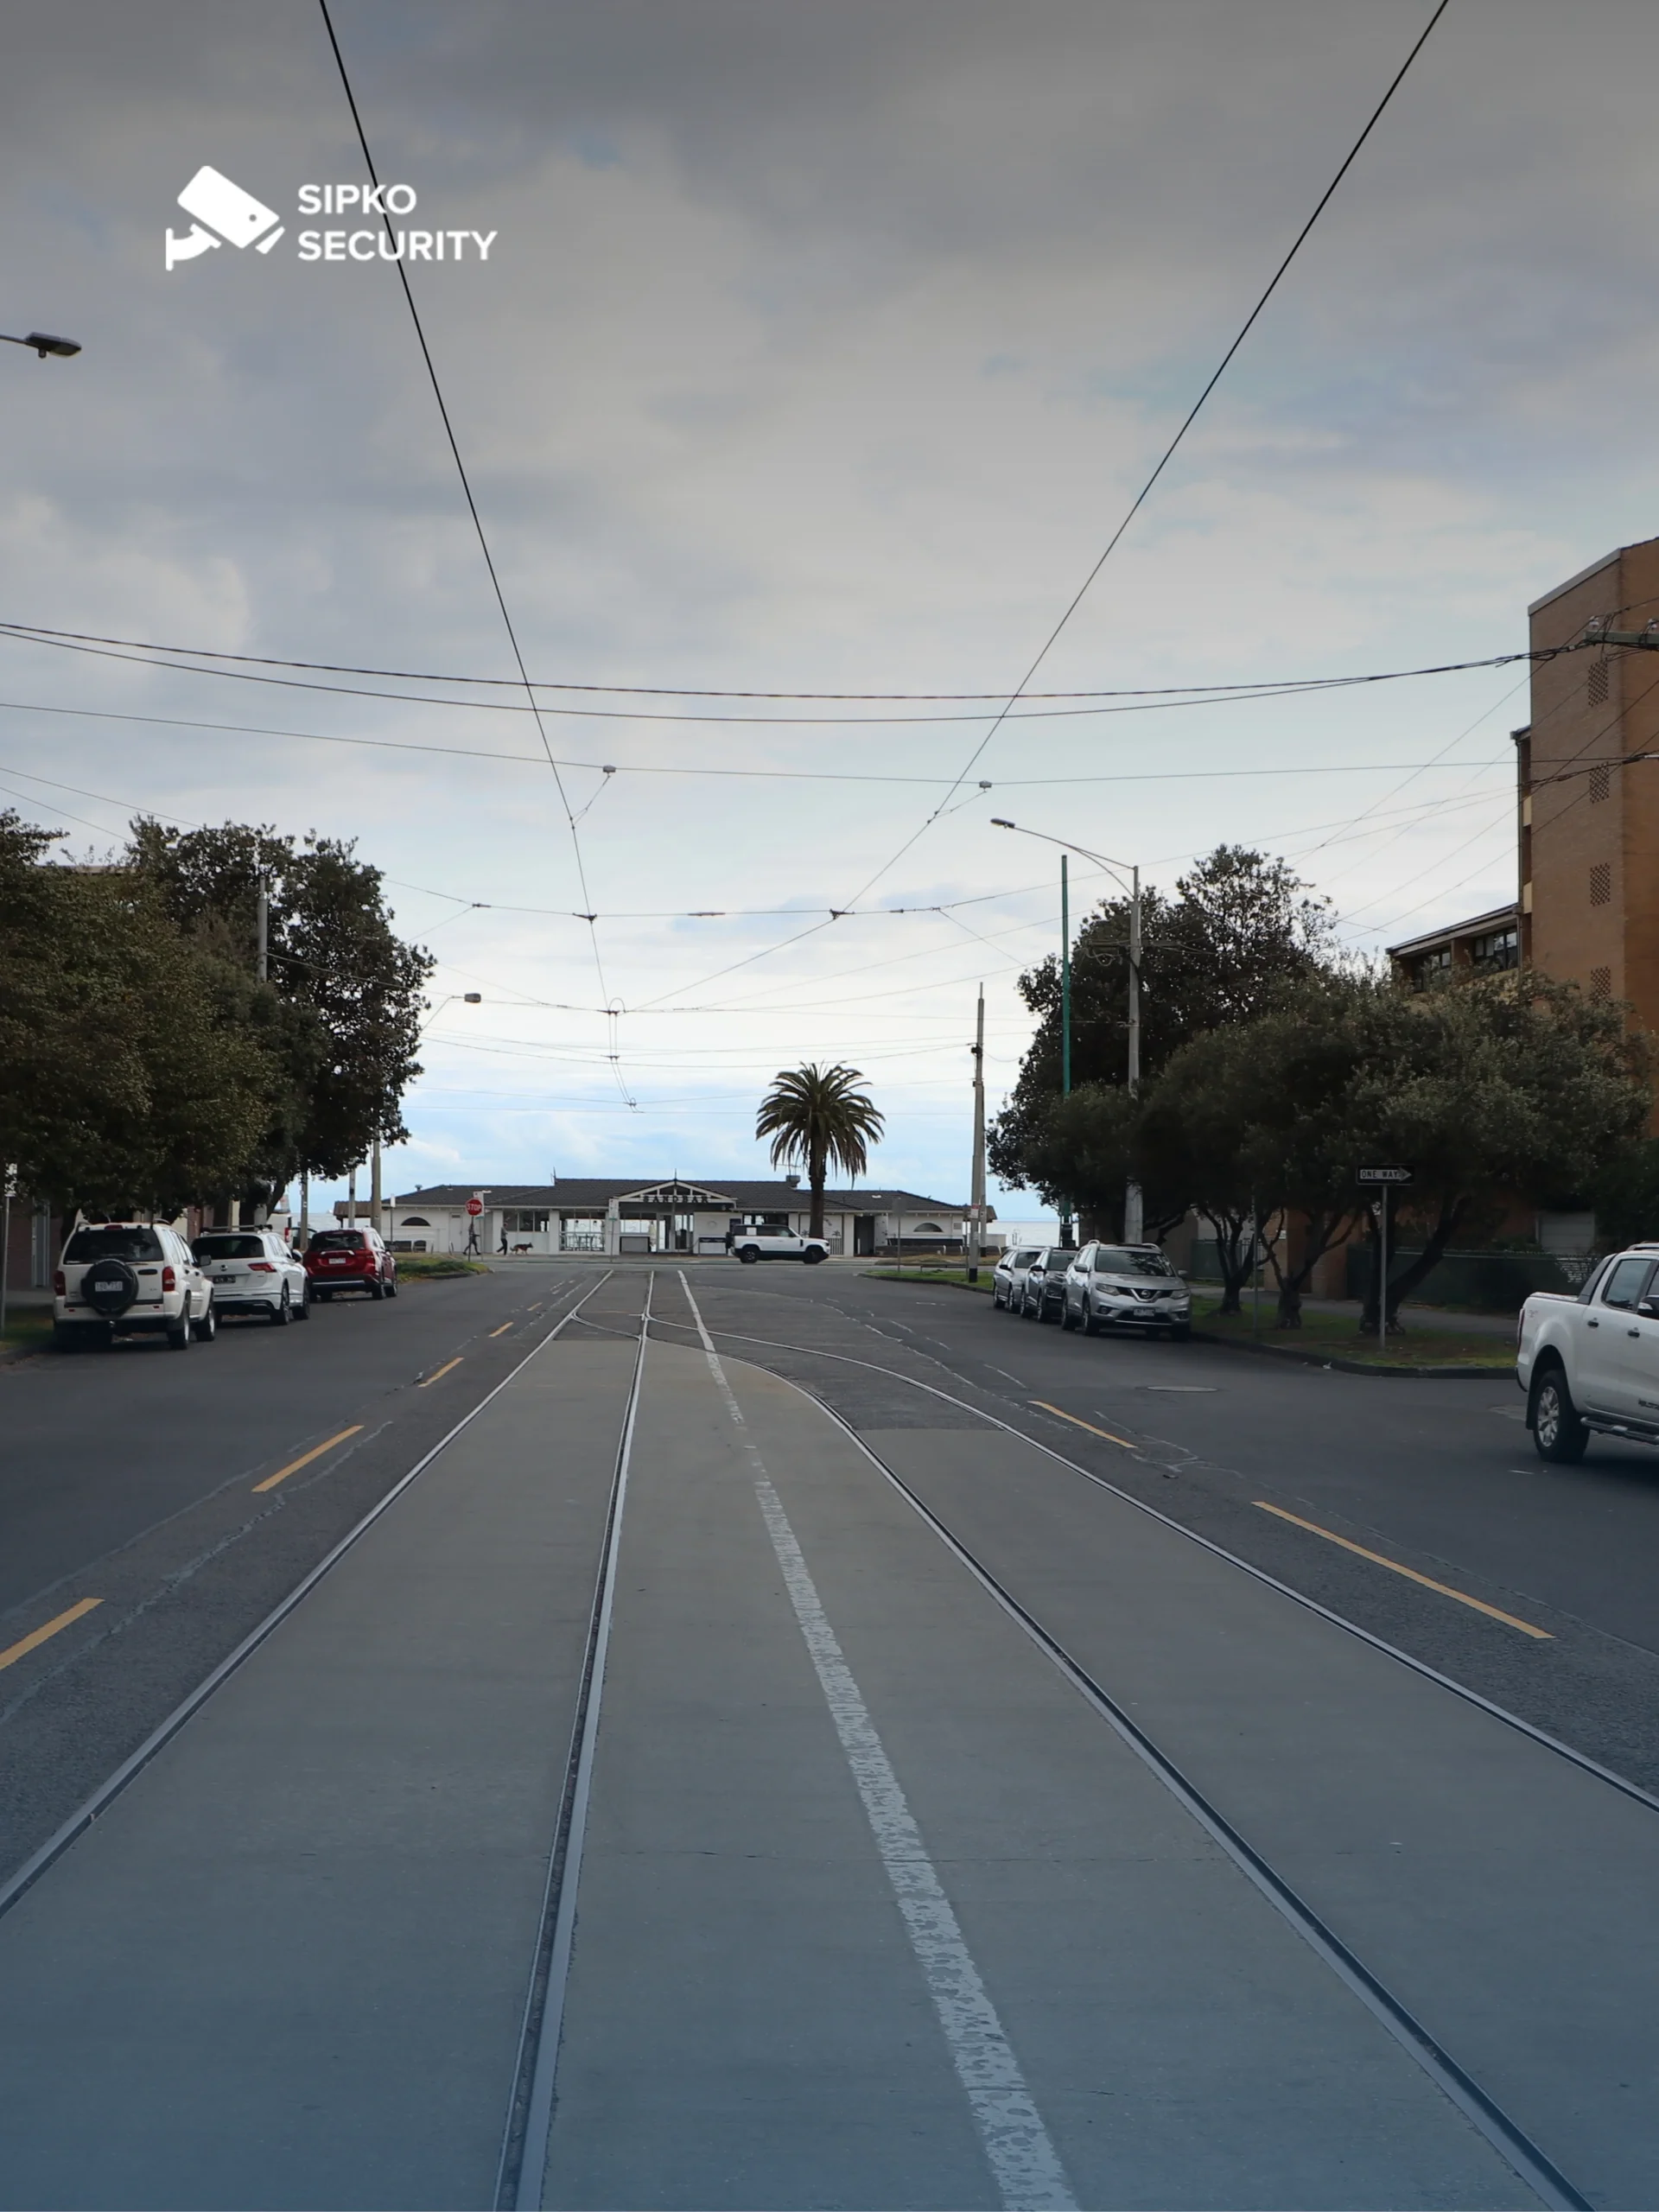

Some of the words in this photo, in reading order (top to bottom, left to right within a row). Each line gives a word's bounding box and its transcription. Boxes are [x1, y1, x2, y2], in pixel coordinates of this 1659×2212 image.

[1361, 1170, 1377, 1179] ONE
[1382, 1170, 1398, 1179] WAY
[643, 1195, 709, 1204] SANDBAR
[467, 1203, 481, 1211] STOP
